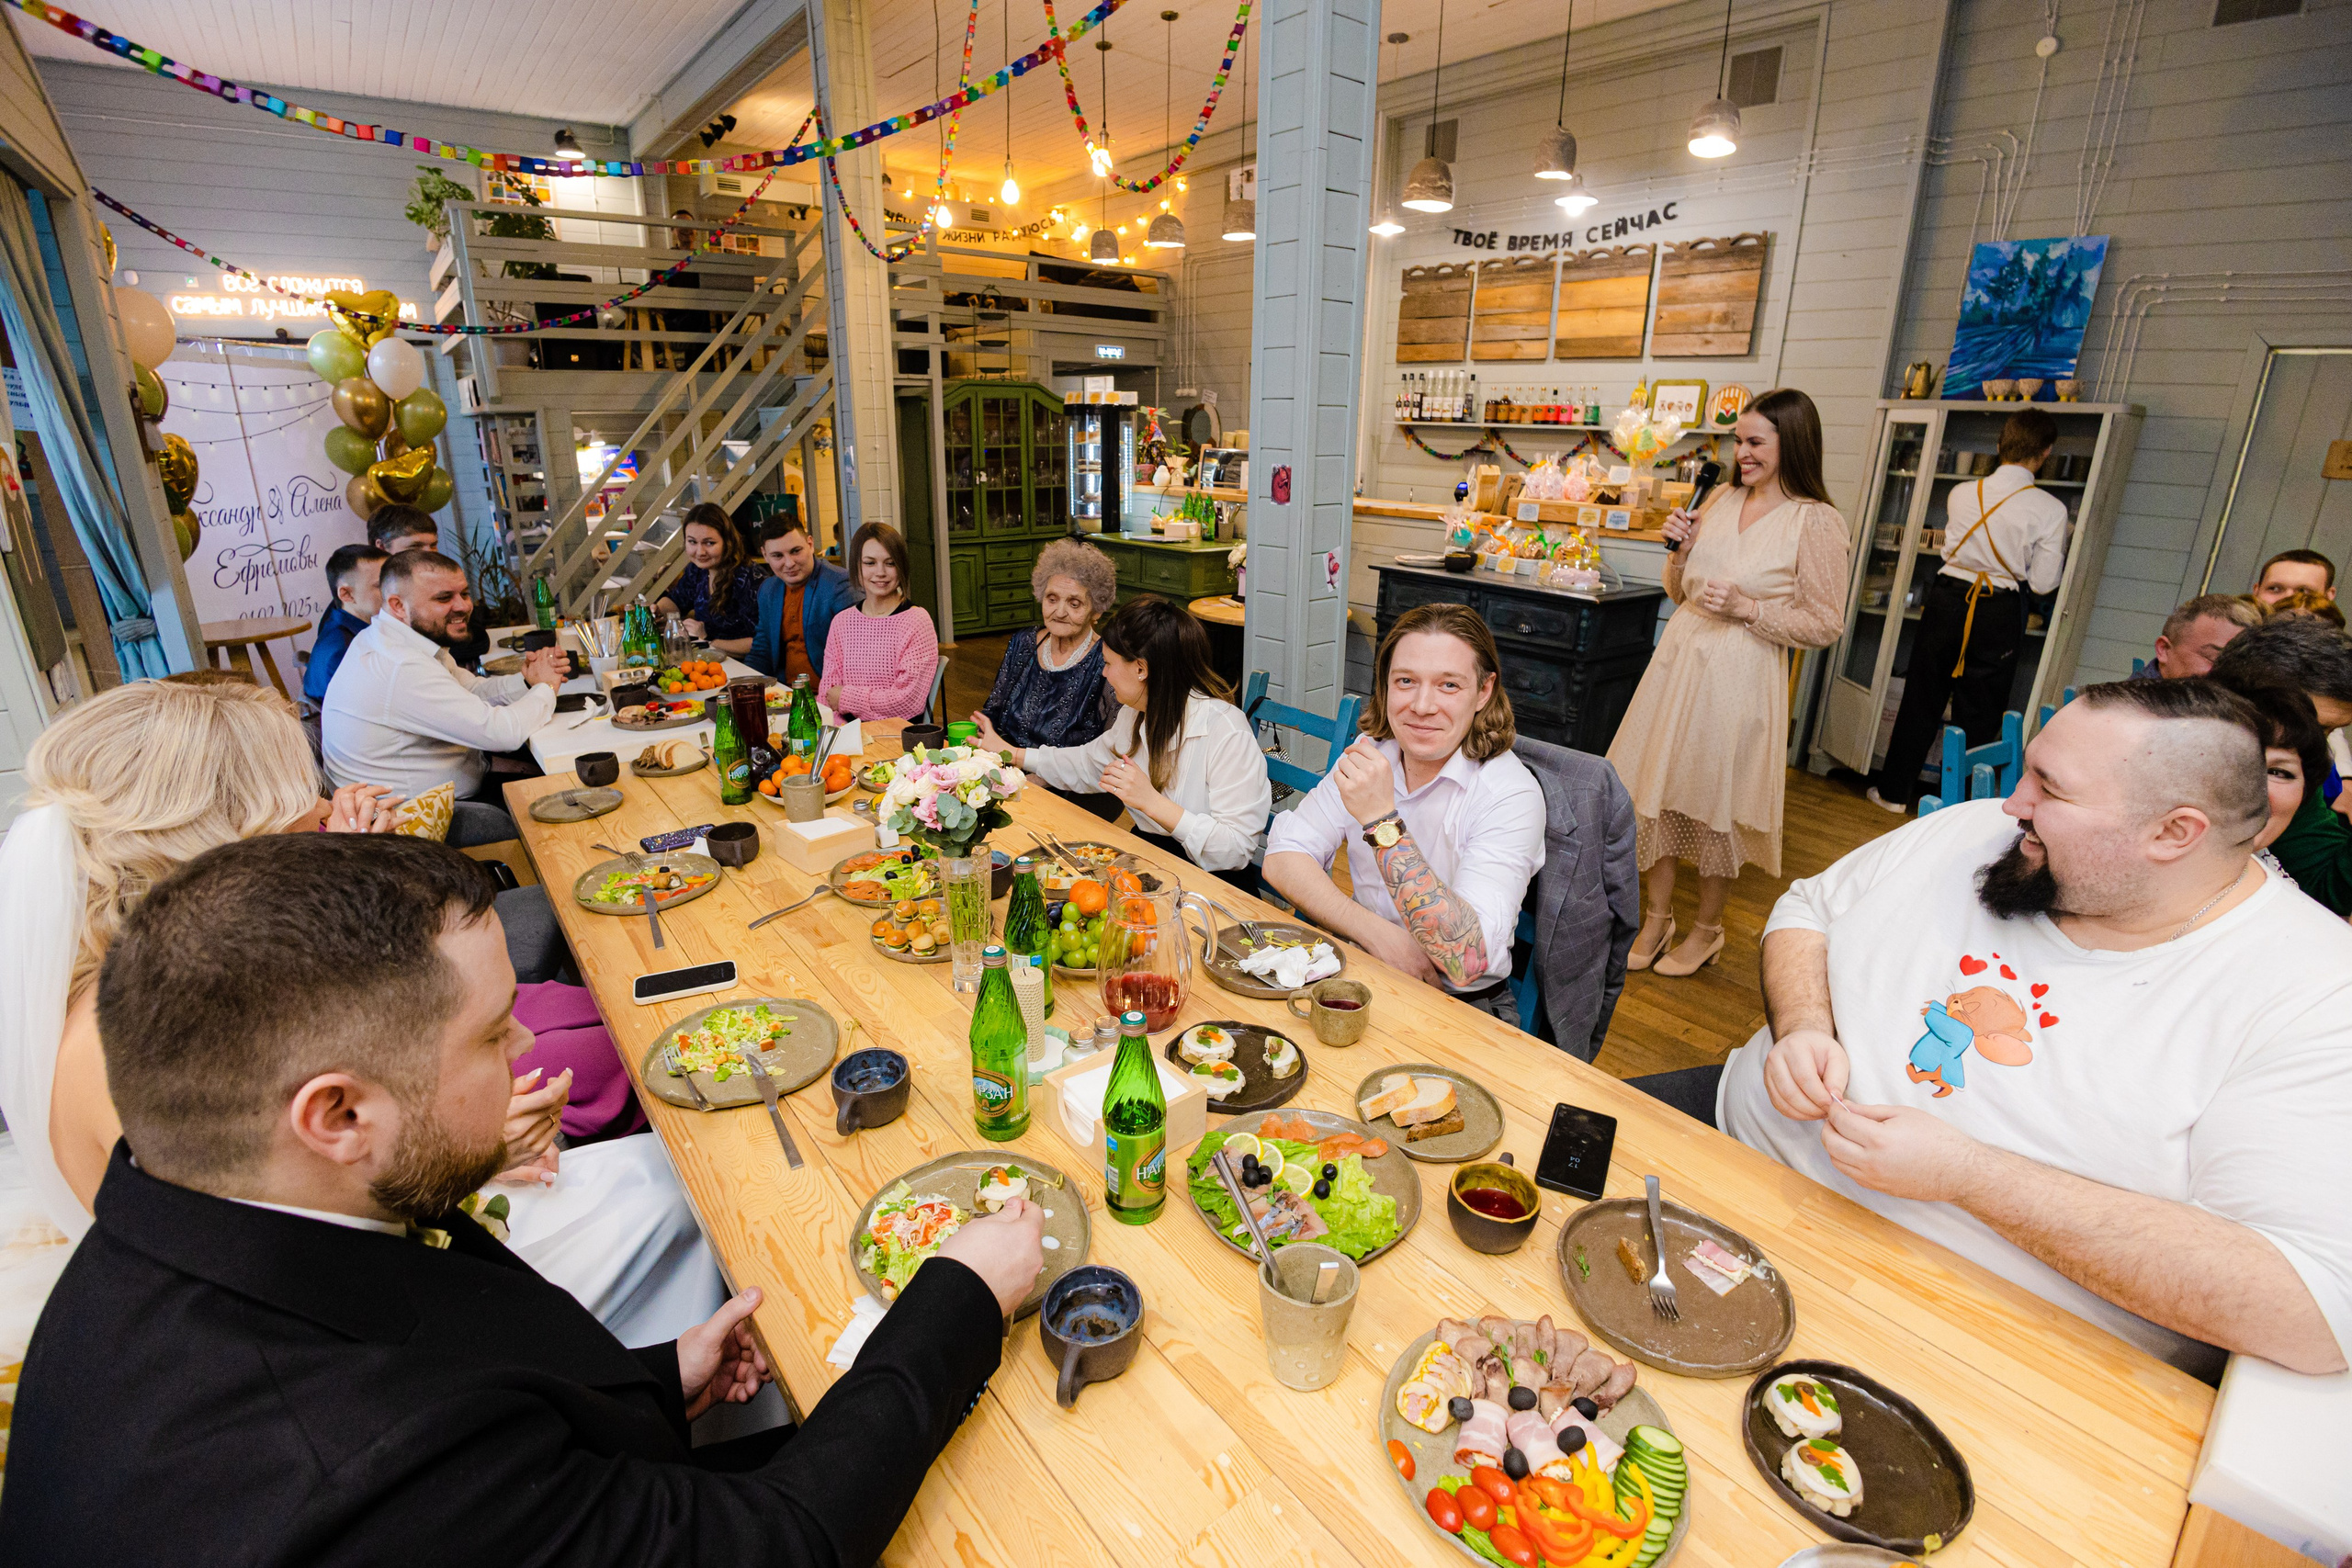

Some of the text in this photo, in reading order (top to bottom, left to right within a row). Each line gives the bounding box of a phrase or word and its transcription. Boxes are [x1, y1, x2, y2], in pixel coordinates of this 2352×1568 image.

[942, 231, 986, 243] ЖИЗНИ
[1453, 201, 1679, 251] ТВОЁ ВРЕМЯ СЕЙЧАС
[194, 493, 263, 536] ксандр
[267, 485, 284, 525] &
[213, 534, 319, 595] Ефремовы
[1136, 1157, 1165, 1181] НАР
